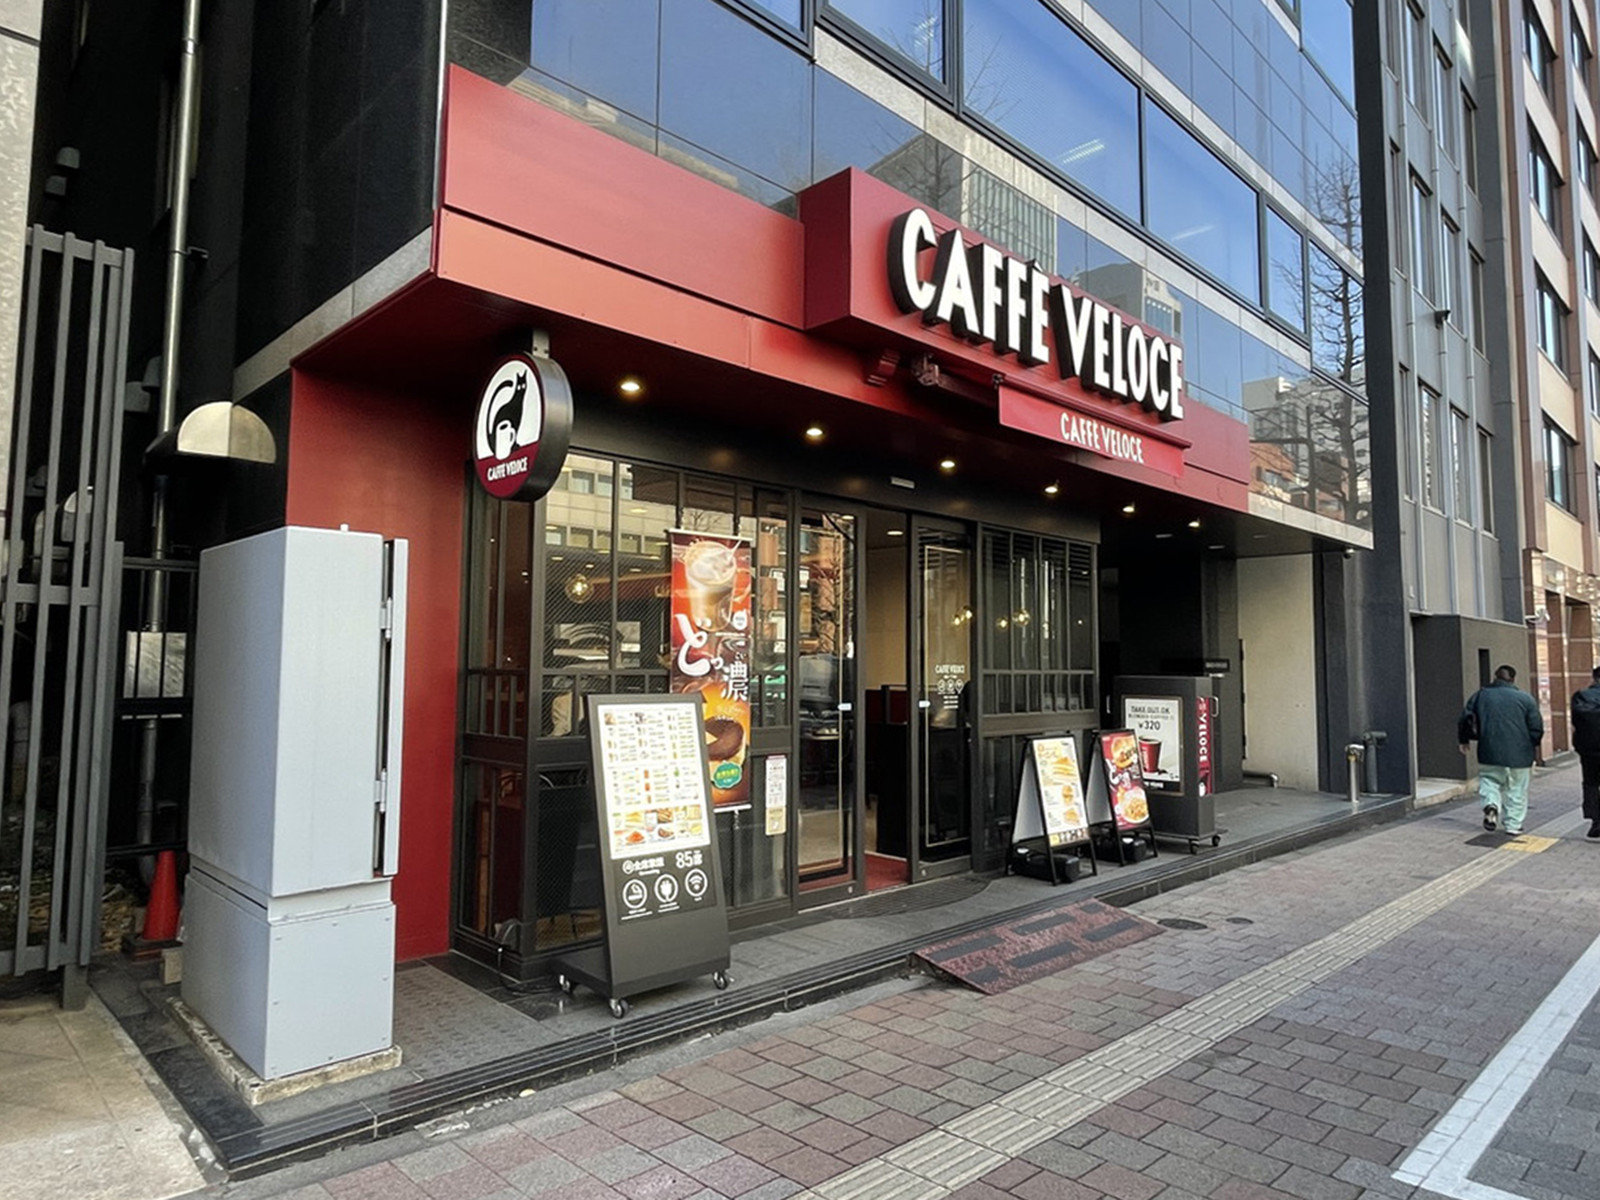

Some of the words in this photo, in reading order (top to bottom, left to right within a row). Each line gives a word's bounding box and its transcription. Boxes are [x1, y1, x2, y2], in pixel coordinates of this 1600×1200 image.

[899, 207, 1050, 364] CAFFÈ
[1057, 283, 1184, 420] VELOCE
[1100, 425, 1144, 464] VELOCE
[1198, 713, 1208, 762] VELOCE
